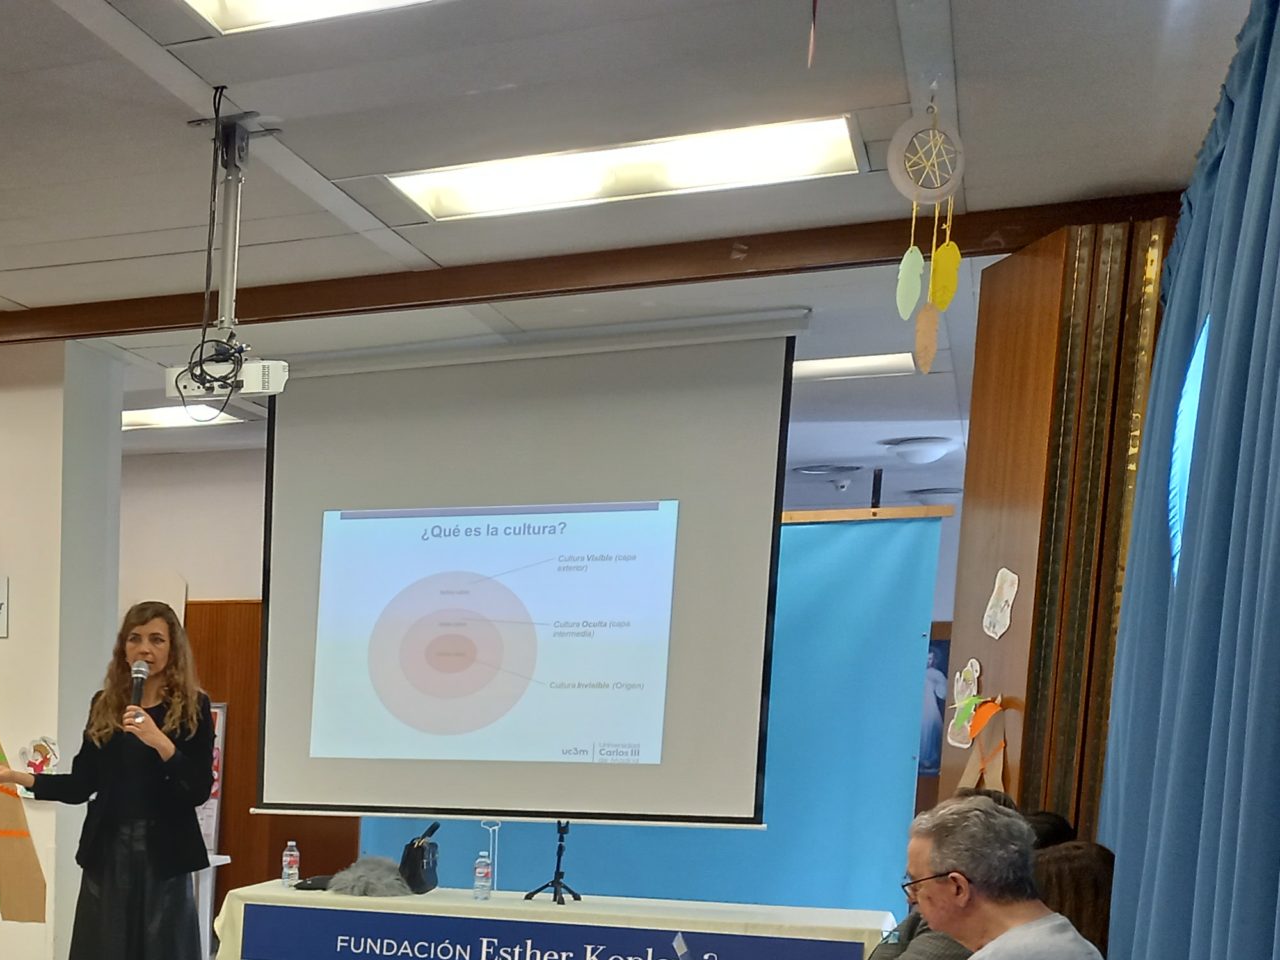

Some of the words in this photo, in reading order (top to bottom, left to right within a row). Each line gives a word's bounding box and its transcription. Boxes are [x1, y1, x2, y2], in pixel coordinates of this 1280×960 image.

[421, 524, 461, 541] ¿Qué
[464, 526, 482, 537] es
[486, 524, 499, 536] la
[503, 522, 567, 536] cultura?
[561, 747, 589, 756] uc3m
[336, 936, 471, 960] FUNDACIÓN
